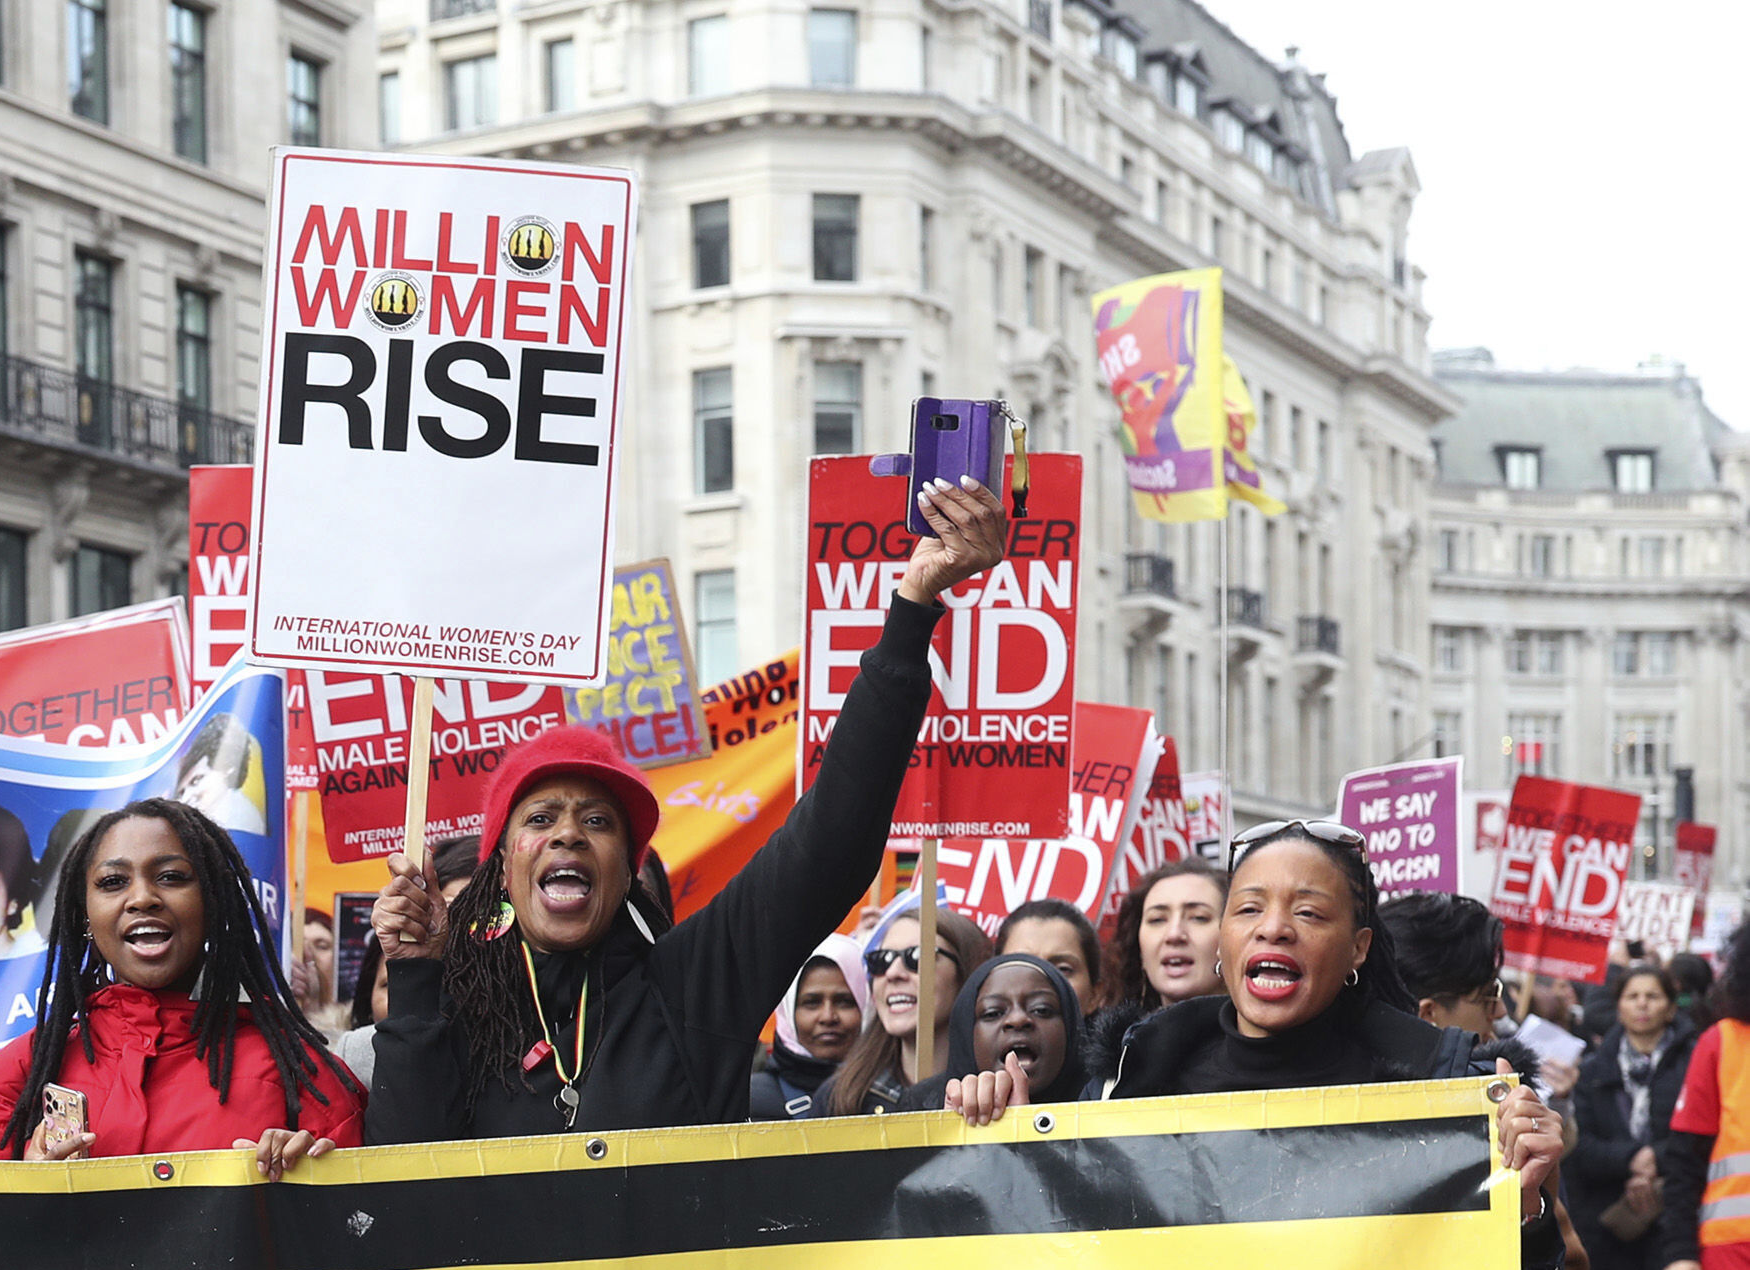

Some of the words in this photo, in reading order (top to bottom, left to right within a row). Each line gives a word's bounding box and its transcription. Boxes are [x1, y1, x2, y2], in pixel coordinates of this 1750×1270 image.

[292, 204, 614, 284] MILLION
[291, 266, 610, 347] WOMEN
[278, 332, 605, 467] RISE
[940, 560, 1073, 609] CAN
[274, 615, 432, 640] INTERNATIONAL
[440, 626, 535, 647] WOMEN'S
[540, 634, 581, 651] DAY
[297, 636, 554, 667] MILLIONWOMENRISE.COM
[808, 608, 1069, 711] END
[574, 673, 683, 722] PECT
[66, 708, 179, 748] CAN
[317, 736, 407, 773] MALE
[432, 712, 560, 757] IOLENCE
[323, 756, 444, 797] AGAINT
[949, 744, 1065, 768] WOMEN
[1359, 797, 1391, 825] WE
[1394, 790, 1438, 820] SAY
[890, 822, 1030, 837] NWOMENRISE.COM
[1369, 828, 1402, 853] NO
[1405, 822, 1436, 851] TO
[1507, 823, 1557, 853] WE
[1562, 834, 1630, 871] CAN
[1369, 853, 1441, 887] RACISM
[1495, 850, 1621, 917] END
[1534, 907, 1614, 938] VIOLENCE
